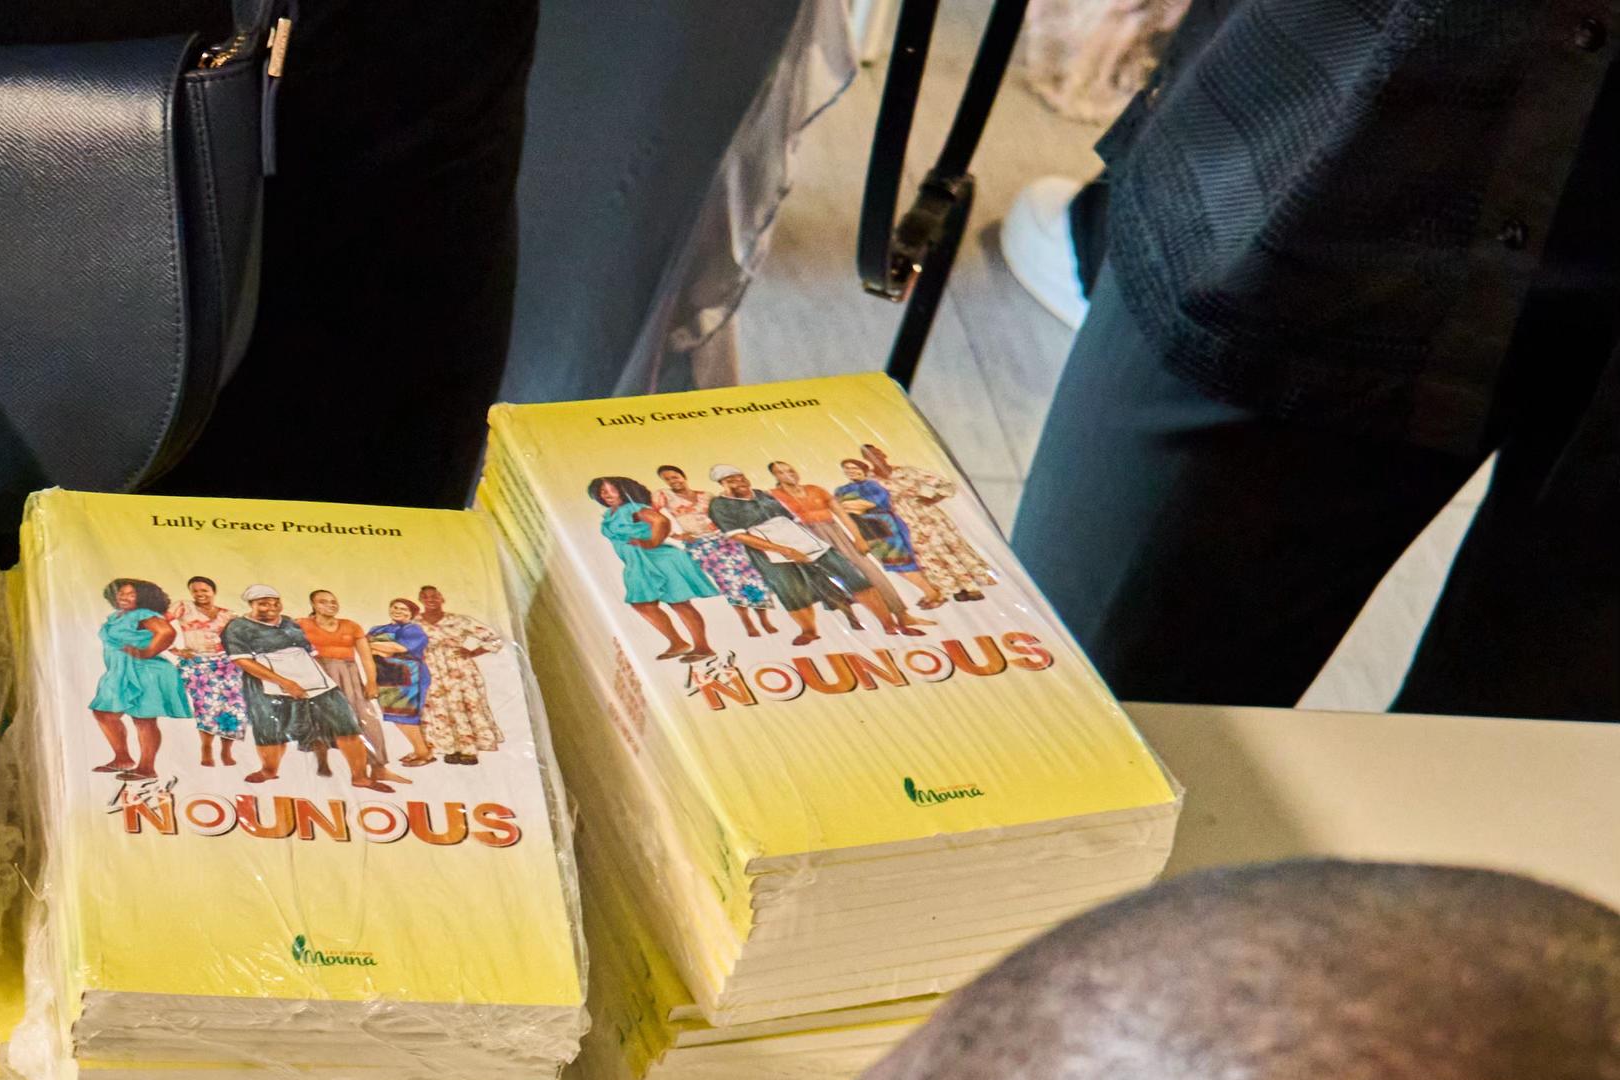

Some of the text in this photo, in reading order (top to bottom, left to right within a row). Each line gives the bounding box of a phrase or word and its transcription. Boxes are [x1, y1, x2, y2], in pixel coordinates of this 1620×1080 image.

[596, 398, 821, 426] Lully Grace Production
[151, 515, 402, 537] Lully Grace Production
[696, 631, 1055, 710] NOUNOUS
[916, 787, 985, 804] Mouna
[121, 791, 523, 848] NOUNOUS
[303, 949, 378, 967] Mouna
